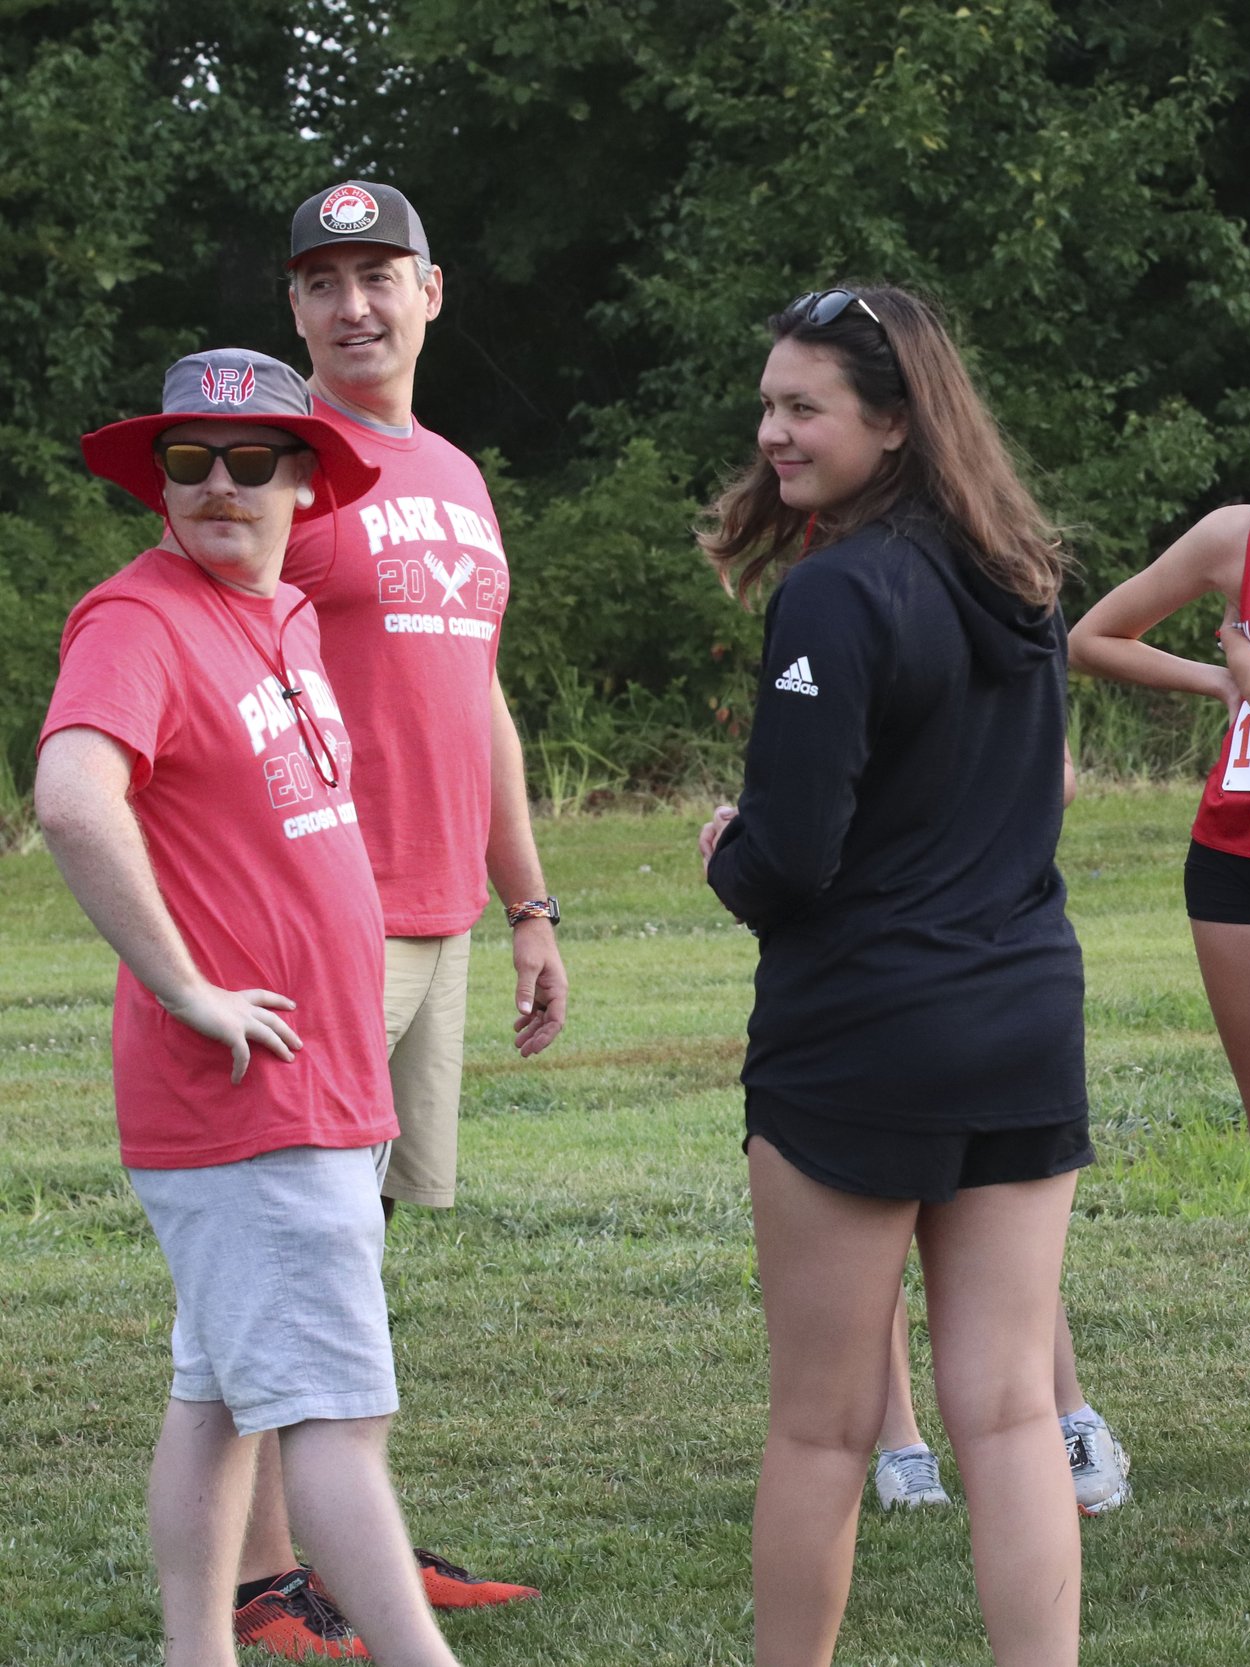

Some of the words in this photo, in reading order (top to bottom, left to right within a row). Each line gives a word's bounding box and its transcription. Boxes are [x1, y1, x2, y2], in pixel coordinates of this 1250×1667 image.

[325, 188, 350, 209] PARK
[352, 188, 369, 206] HILL
[328, 217, 372, 230] TROJANS
[359, 497, 447, 556] PARK
[442, 500, 508, 568] HILL
[377, 560, 426, 604] 20
[384, 613, 445, 634] CROSS
[775, 677, 819, 696] addas
[263, 752, 314, 810] 20
[283, 806, 338, 840] CROSS
